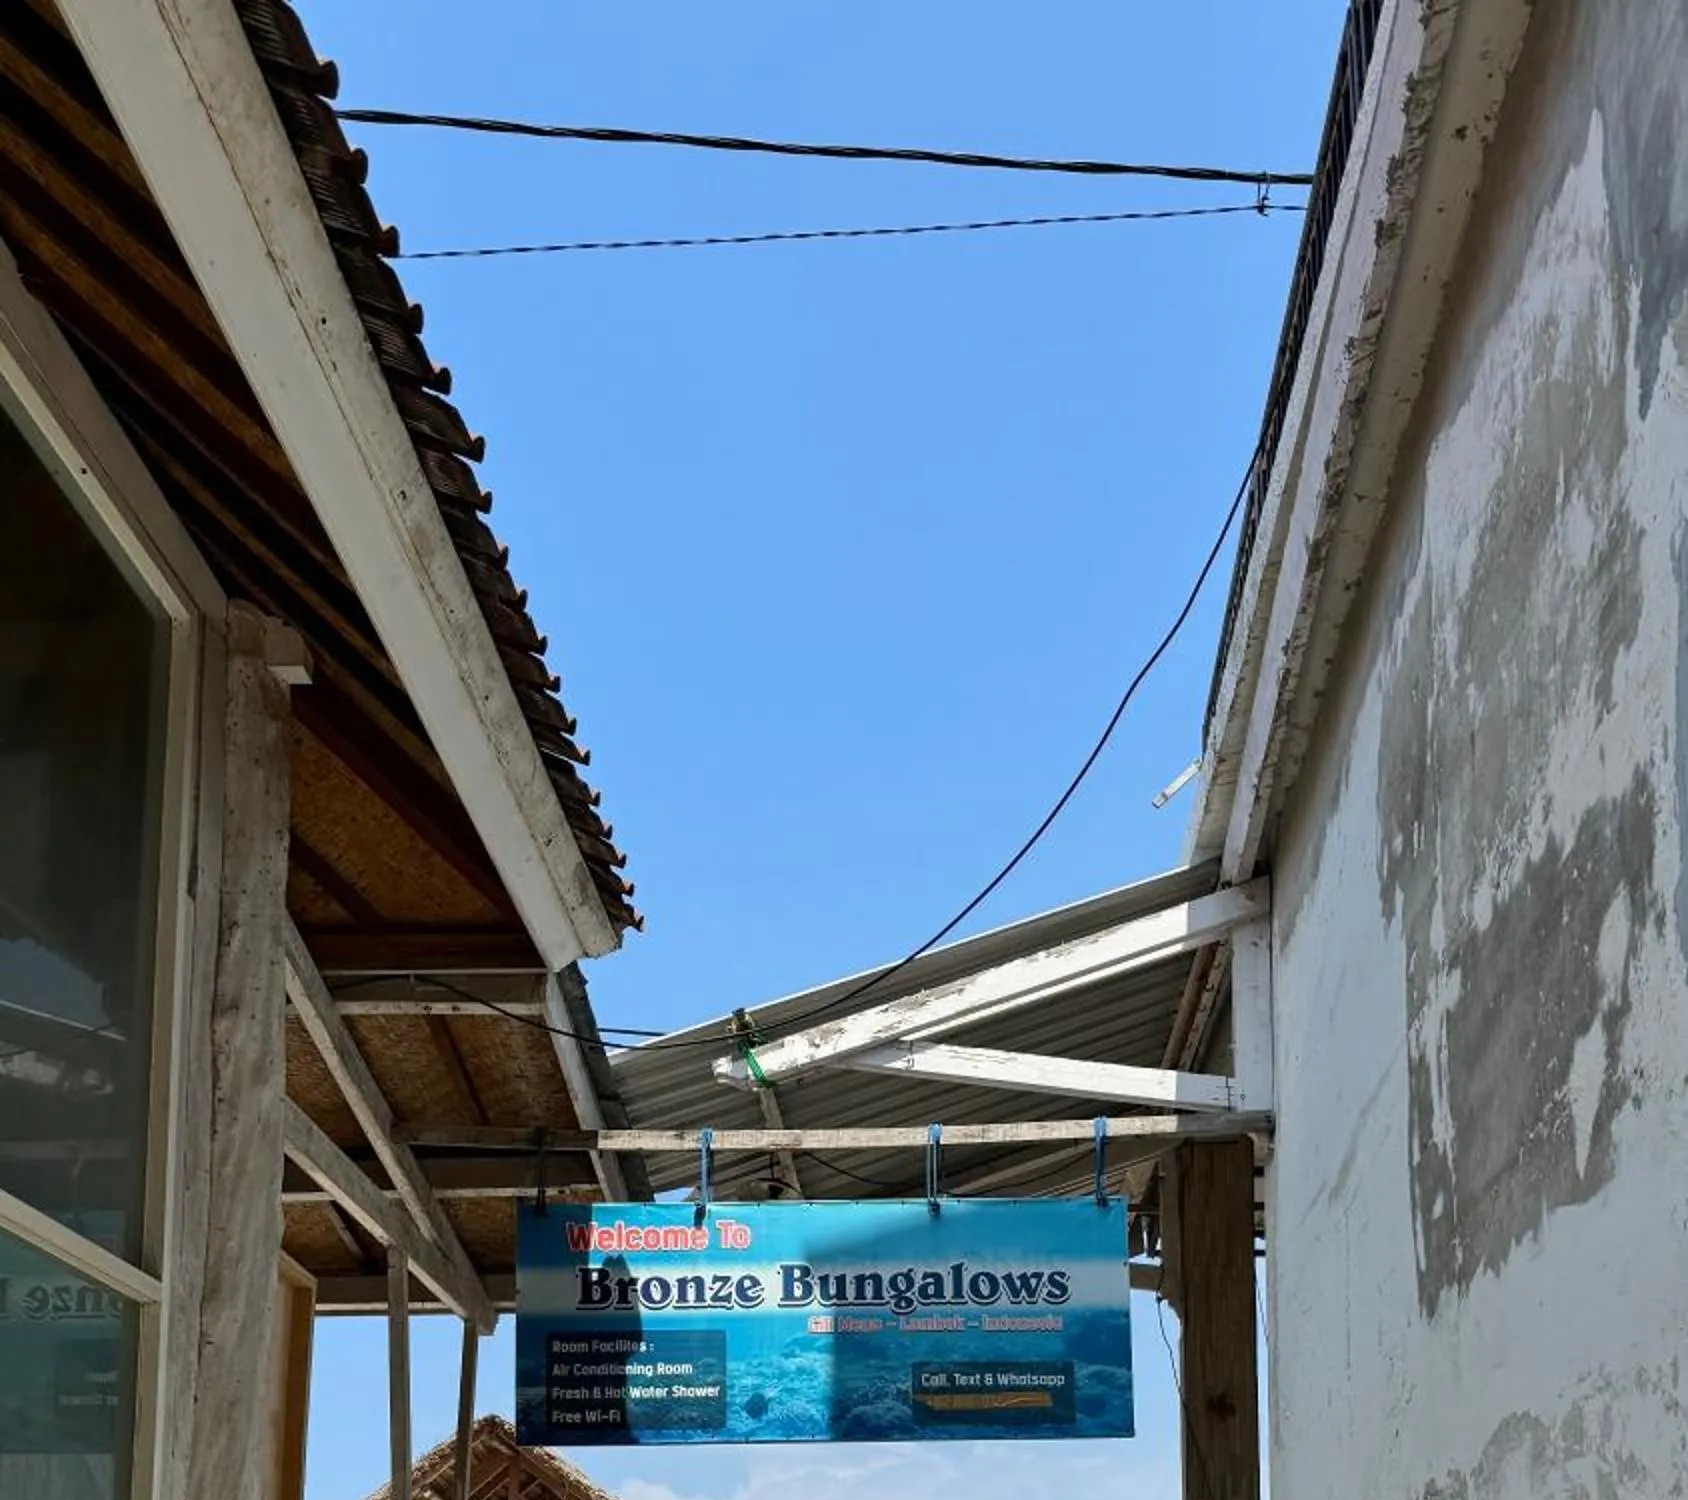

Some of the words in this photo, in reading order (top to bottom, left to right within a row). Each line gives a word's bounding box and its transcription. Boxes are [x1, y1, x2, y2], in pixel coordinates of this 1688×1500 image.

[567, 1221, 709, 1251] Welcome
[716, 1220, 751, 1248] To
[576, 1266, 765, 1310] Bronze
[777, 1260, 1073, 1315] Bungalows
[552, 1340, 589, 1352] Room
[552, 1363, 570, 1376] Air
[573, 1363, 653, 1378] Conditioning
[657, 1363, 693, 1375] Room
[953, 1373, 981, 1386] Text
[984, 1373, 993, 1386] &
[997, 1373, 1065, 1387] Whatsapp
[552, 1386, 589, 1399] Fresh
[593, 1387, 601, 1399] &
[604, 1386, 626, 1399] Hot
[629, 1386, 668, 1399] Water
[671, 1385, 721, 1398] Shower
[552, 1410, 582, 1423] Free
[585, 1410, 621, 1423] Wi-Fi
